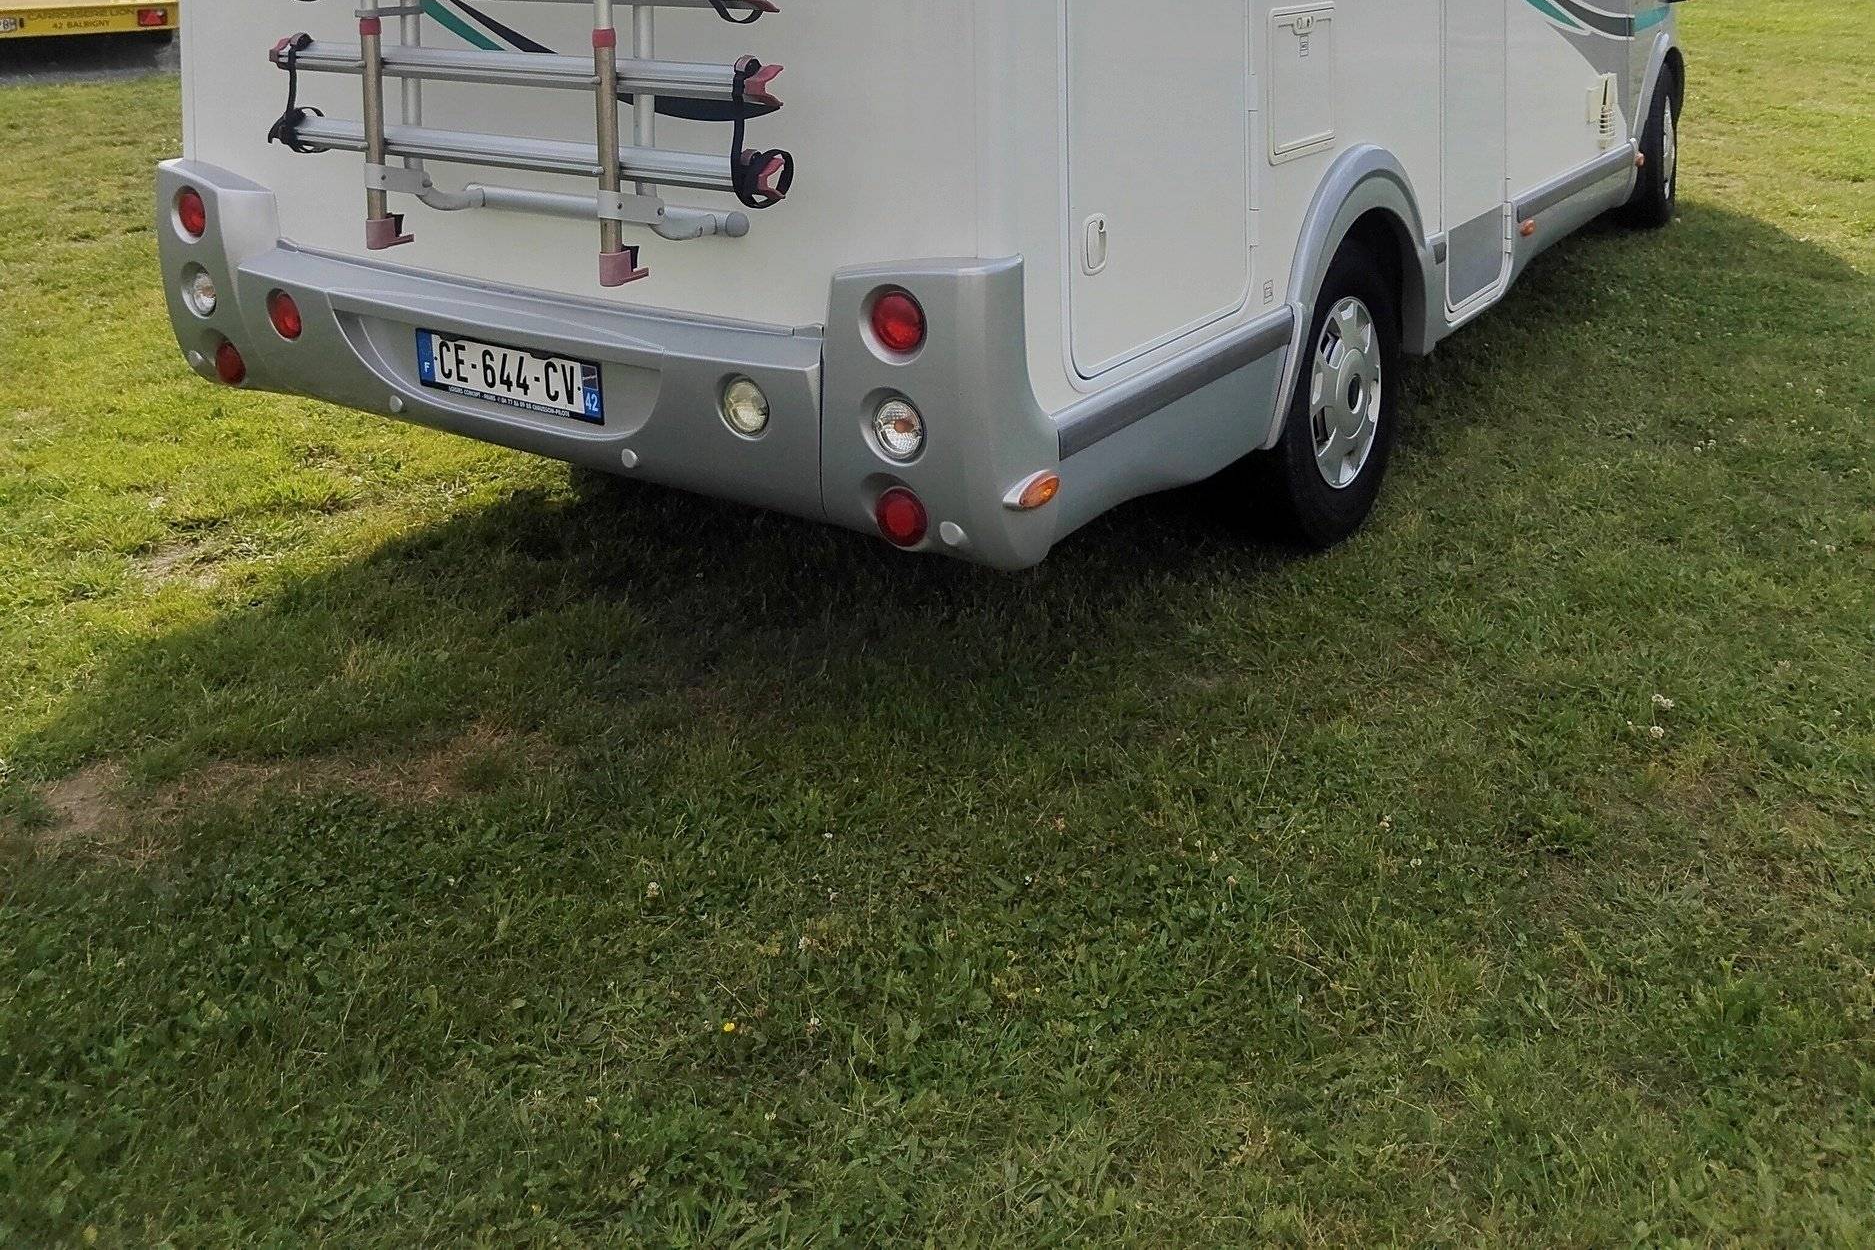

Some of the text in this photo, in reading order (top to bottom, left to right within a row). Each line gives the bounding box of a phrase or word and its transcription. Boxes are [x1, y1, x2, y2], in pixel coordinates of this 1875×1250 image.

[423, 361, 430, 373] F
[438, 340, 575, 405] CE-644-CV
[585, 392, 600, 413] 42
